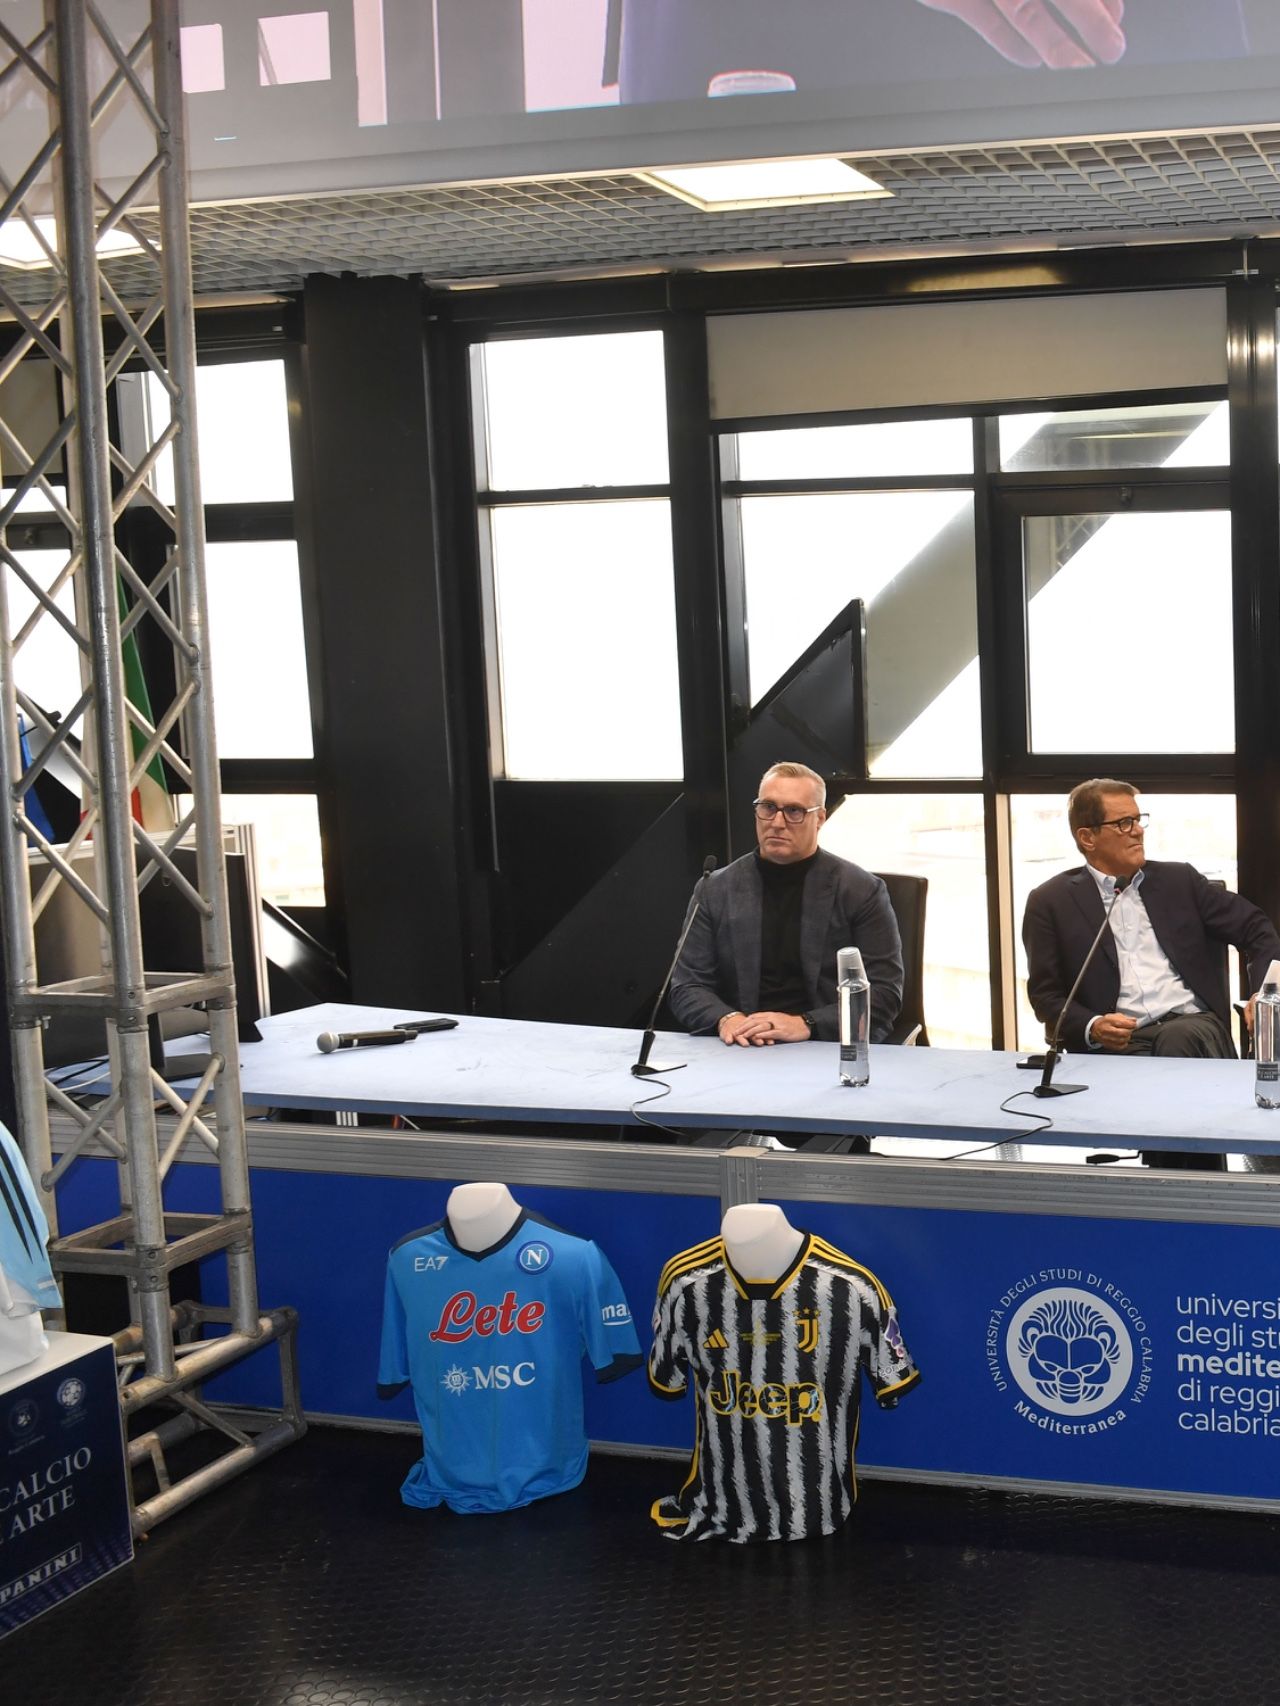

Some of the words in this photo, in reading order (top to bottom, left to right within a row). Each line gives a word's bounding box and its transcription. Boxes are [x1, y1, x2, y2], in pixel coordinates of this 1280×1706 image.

[414, 1256, 449, 1273] EA7
[526, 1249, 543, 1266] N
[429, 1290, 546, 1344] Lete
[602, 1303, 631, 1321] ma
[986, 1308, 1008, 1392] UNIVERSITÀ
[1000, 1274, 1037, 1307] DEGLI
[1039, 1268, 1083, 1282] STUDI
[1086, 1273, 1102, 1288] DI
[1104, 1283, 1147, 1333] REGGIO
[1130, 1336, 1153, 1404] CALABRIA
[1176, 1319, 1244, 1352] degli
[472, 1362, 536, 1390] MSC
[1178, 1377, 1201, 1402] di
[710, 1368, 821, 1427] Jeep
[1013, 1400, 1127, 1435] Mediterranea
[9, 1485, 76, 1540] ARTE
[0, 1549, 78, 1602] PANINI
